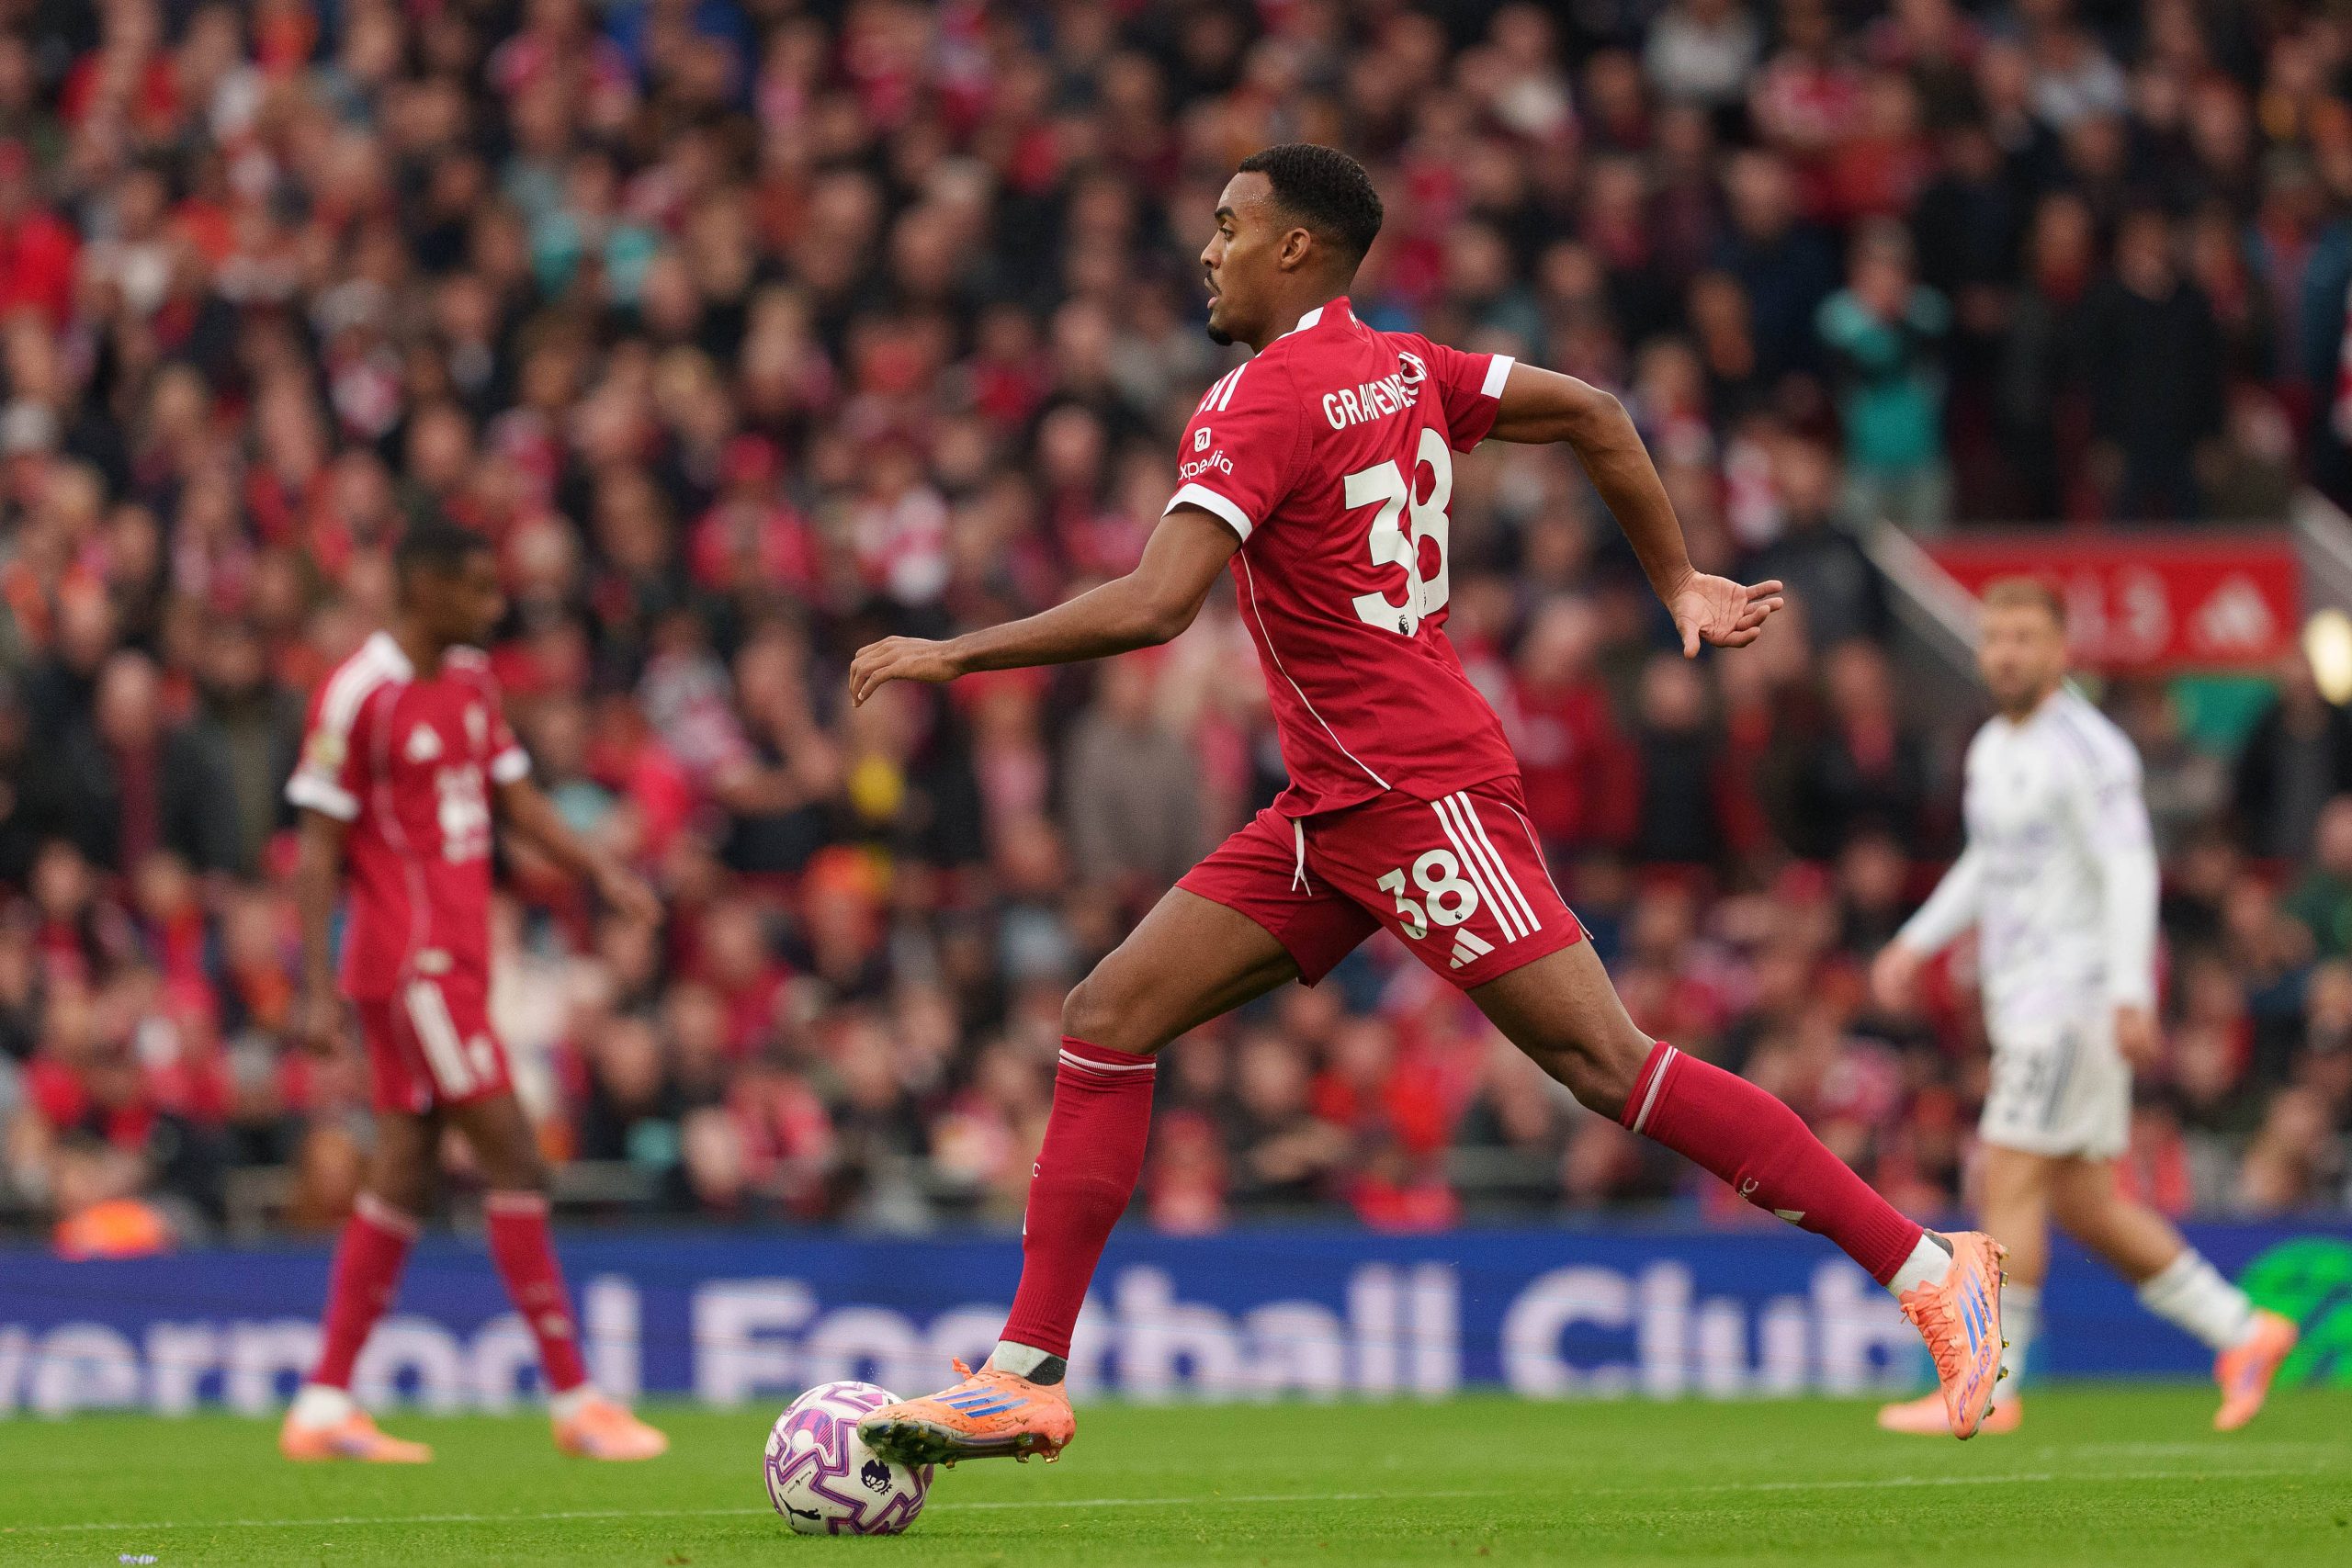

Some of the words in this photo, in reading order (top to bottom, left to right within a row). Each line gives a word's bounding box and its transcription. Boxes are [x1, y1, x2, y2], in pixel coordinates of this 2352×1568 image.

[1178, 450, 1234, 480] xpedia
[1344, 427, 1453, 638] 38
[1376, 849, 1479, 940] 38
[1502, 1260, 1920, 1398] Club
